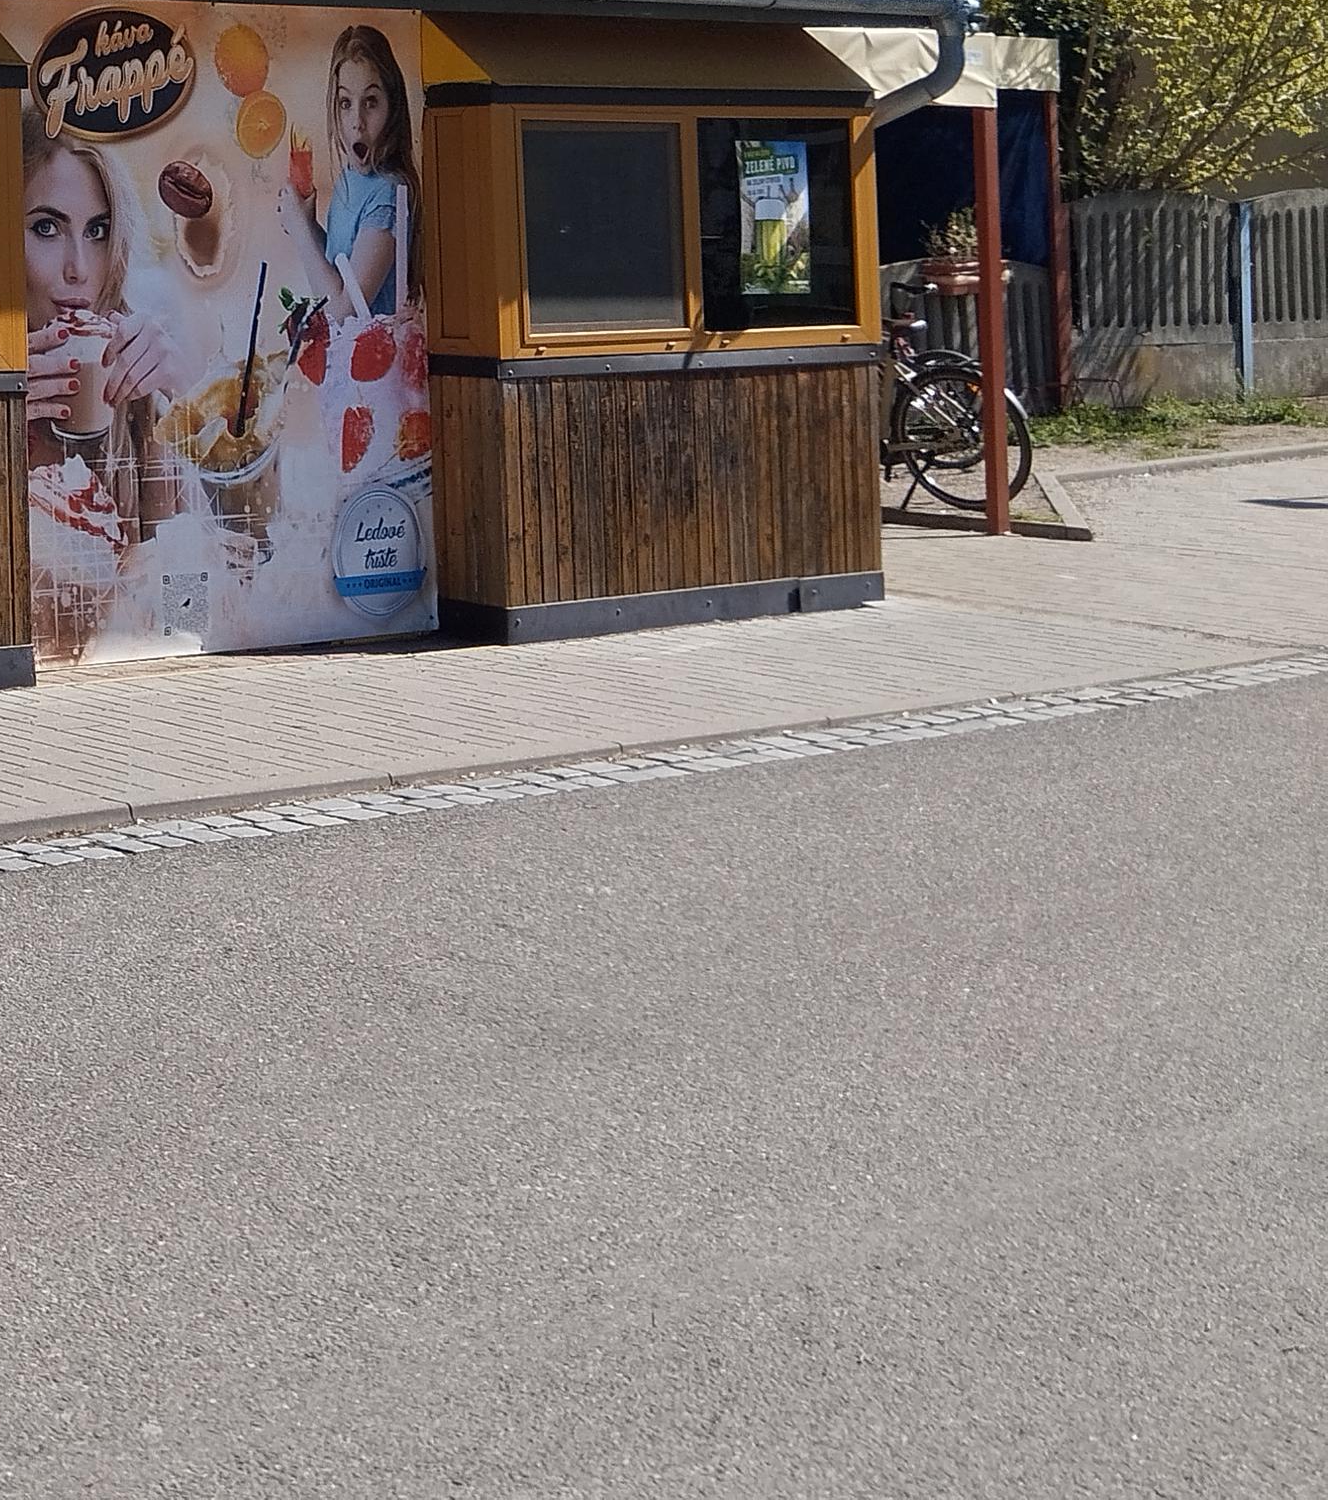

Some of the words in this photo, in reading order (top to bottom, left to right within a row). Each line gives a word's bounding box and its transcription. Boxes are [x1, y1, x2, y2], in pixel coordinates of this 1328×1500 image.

[95, 20, 154, 58] káva
[39, 23, 194, 139] Frappé
[354, 516, 406, 543] Ledové
